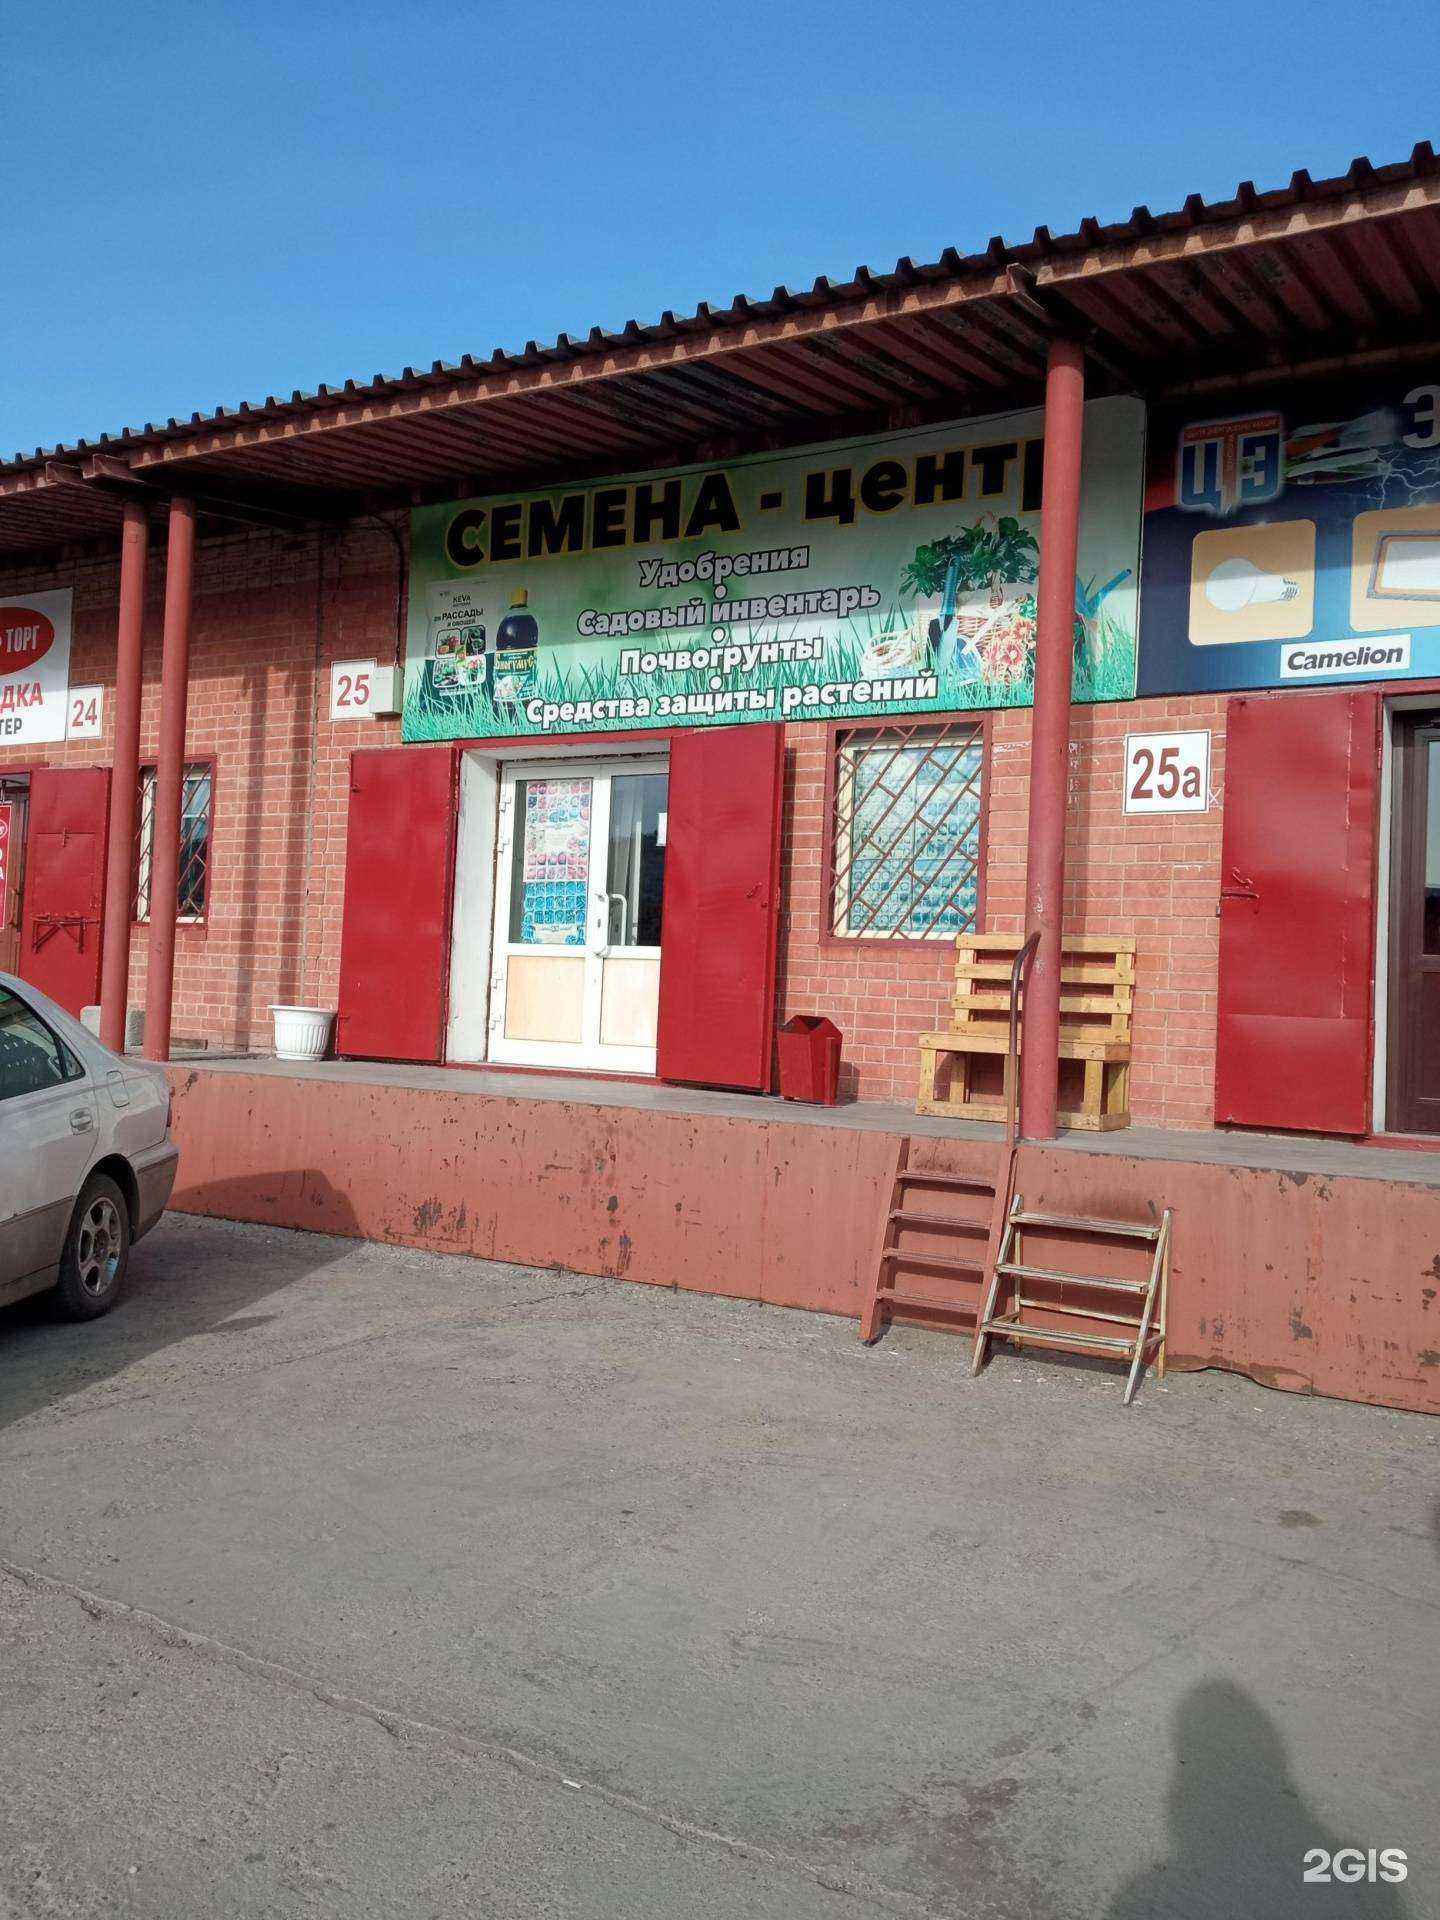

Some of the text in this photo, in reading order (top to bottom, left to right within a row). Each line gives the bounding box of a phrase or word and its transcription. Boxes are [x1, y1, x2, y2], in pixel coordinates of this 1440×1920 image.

[445, 471, 742, 568] СЕМЕНА
[638, 545, 810, 588] Удобрения
[442, 608, 484, 621] РАССАДЫ
[577, 584, 881, 637] Садовый инвентарь
[6, 625, 40, 653] ТОРГ
[620, 637, 823, 675] Почвогрунты
[1286, 646, 1403, 671] Camelion
[336, 674, 370, 706] 25
[526, 669, 939, 730] Средства защиты растений
[71, 697, 98, 727] 24
[1130, 747, 1202, 800] 25а
